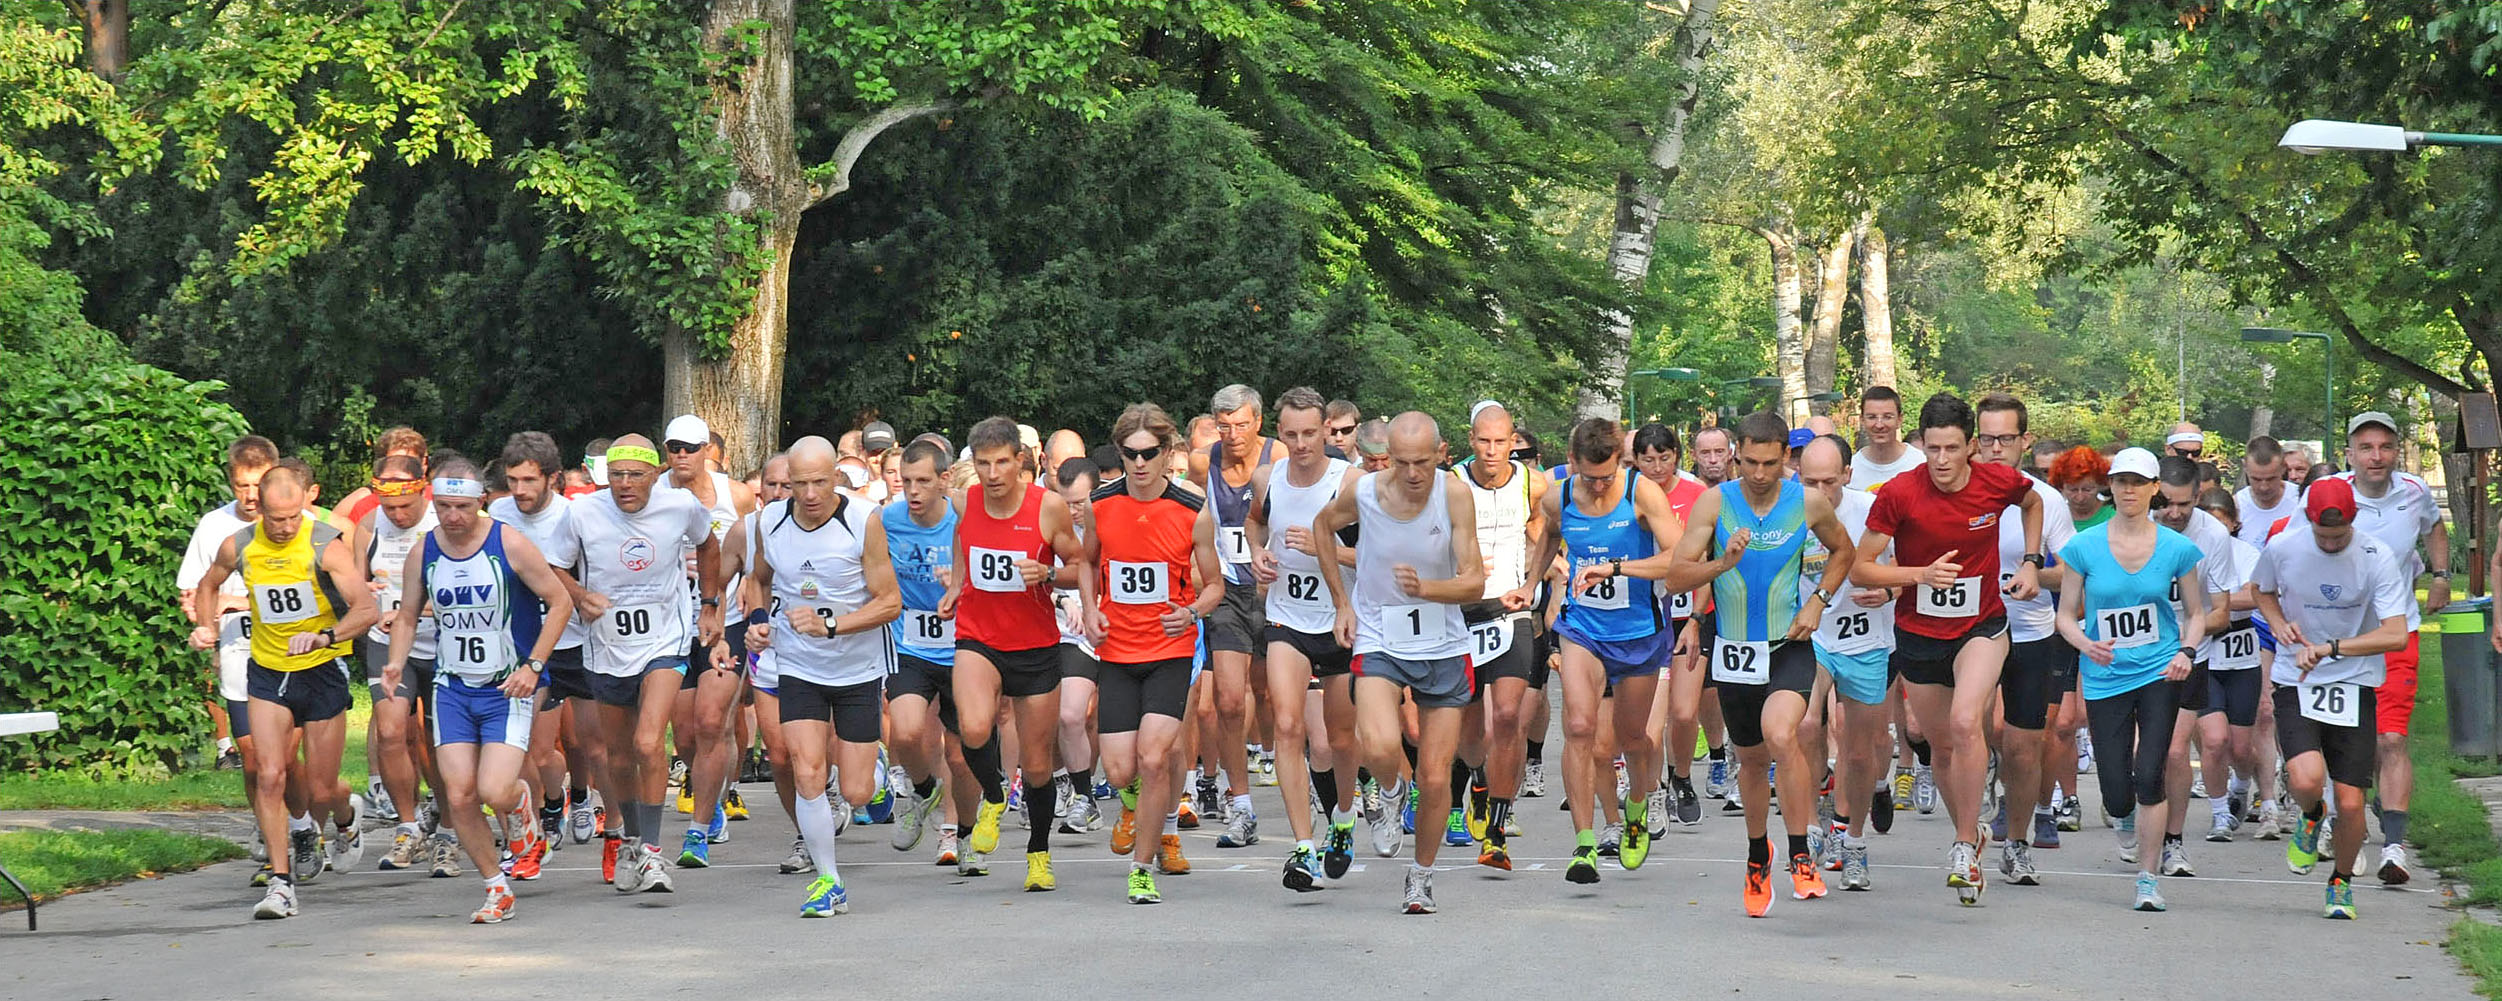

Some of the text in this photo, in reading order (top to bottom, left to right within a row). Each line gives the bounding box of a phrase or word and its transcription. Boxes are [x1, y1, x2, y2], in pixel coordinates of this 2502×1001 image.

[1588, 545, 1609, 554] Team
[981, 553, 1013, 581] 93
[1121, 567, 1155, 594] 39
[268, 588, 302, 613] 88
[1288, 573, 1319, 601] 82
[1931, 583, 1966, 607] 85
[442, 610, 495, 629] OMV
[615, 608, 650, 636] 90
[915, 614, 943, 639] 18
[1407, 608, 1421, 636] 1
[1836, 612, 1870, 641] 25
[2105, 609, 2152, 638] 104
[454, 636, 486, 663] 76
[1472, 626, 1502, 655] 73
[2221, 632, 2254, 659] 120
[1722, 644, 1756, 673] 62
[2311, 685, 2345, 715] 26
